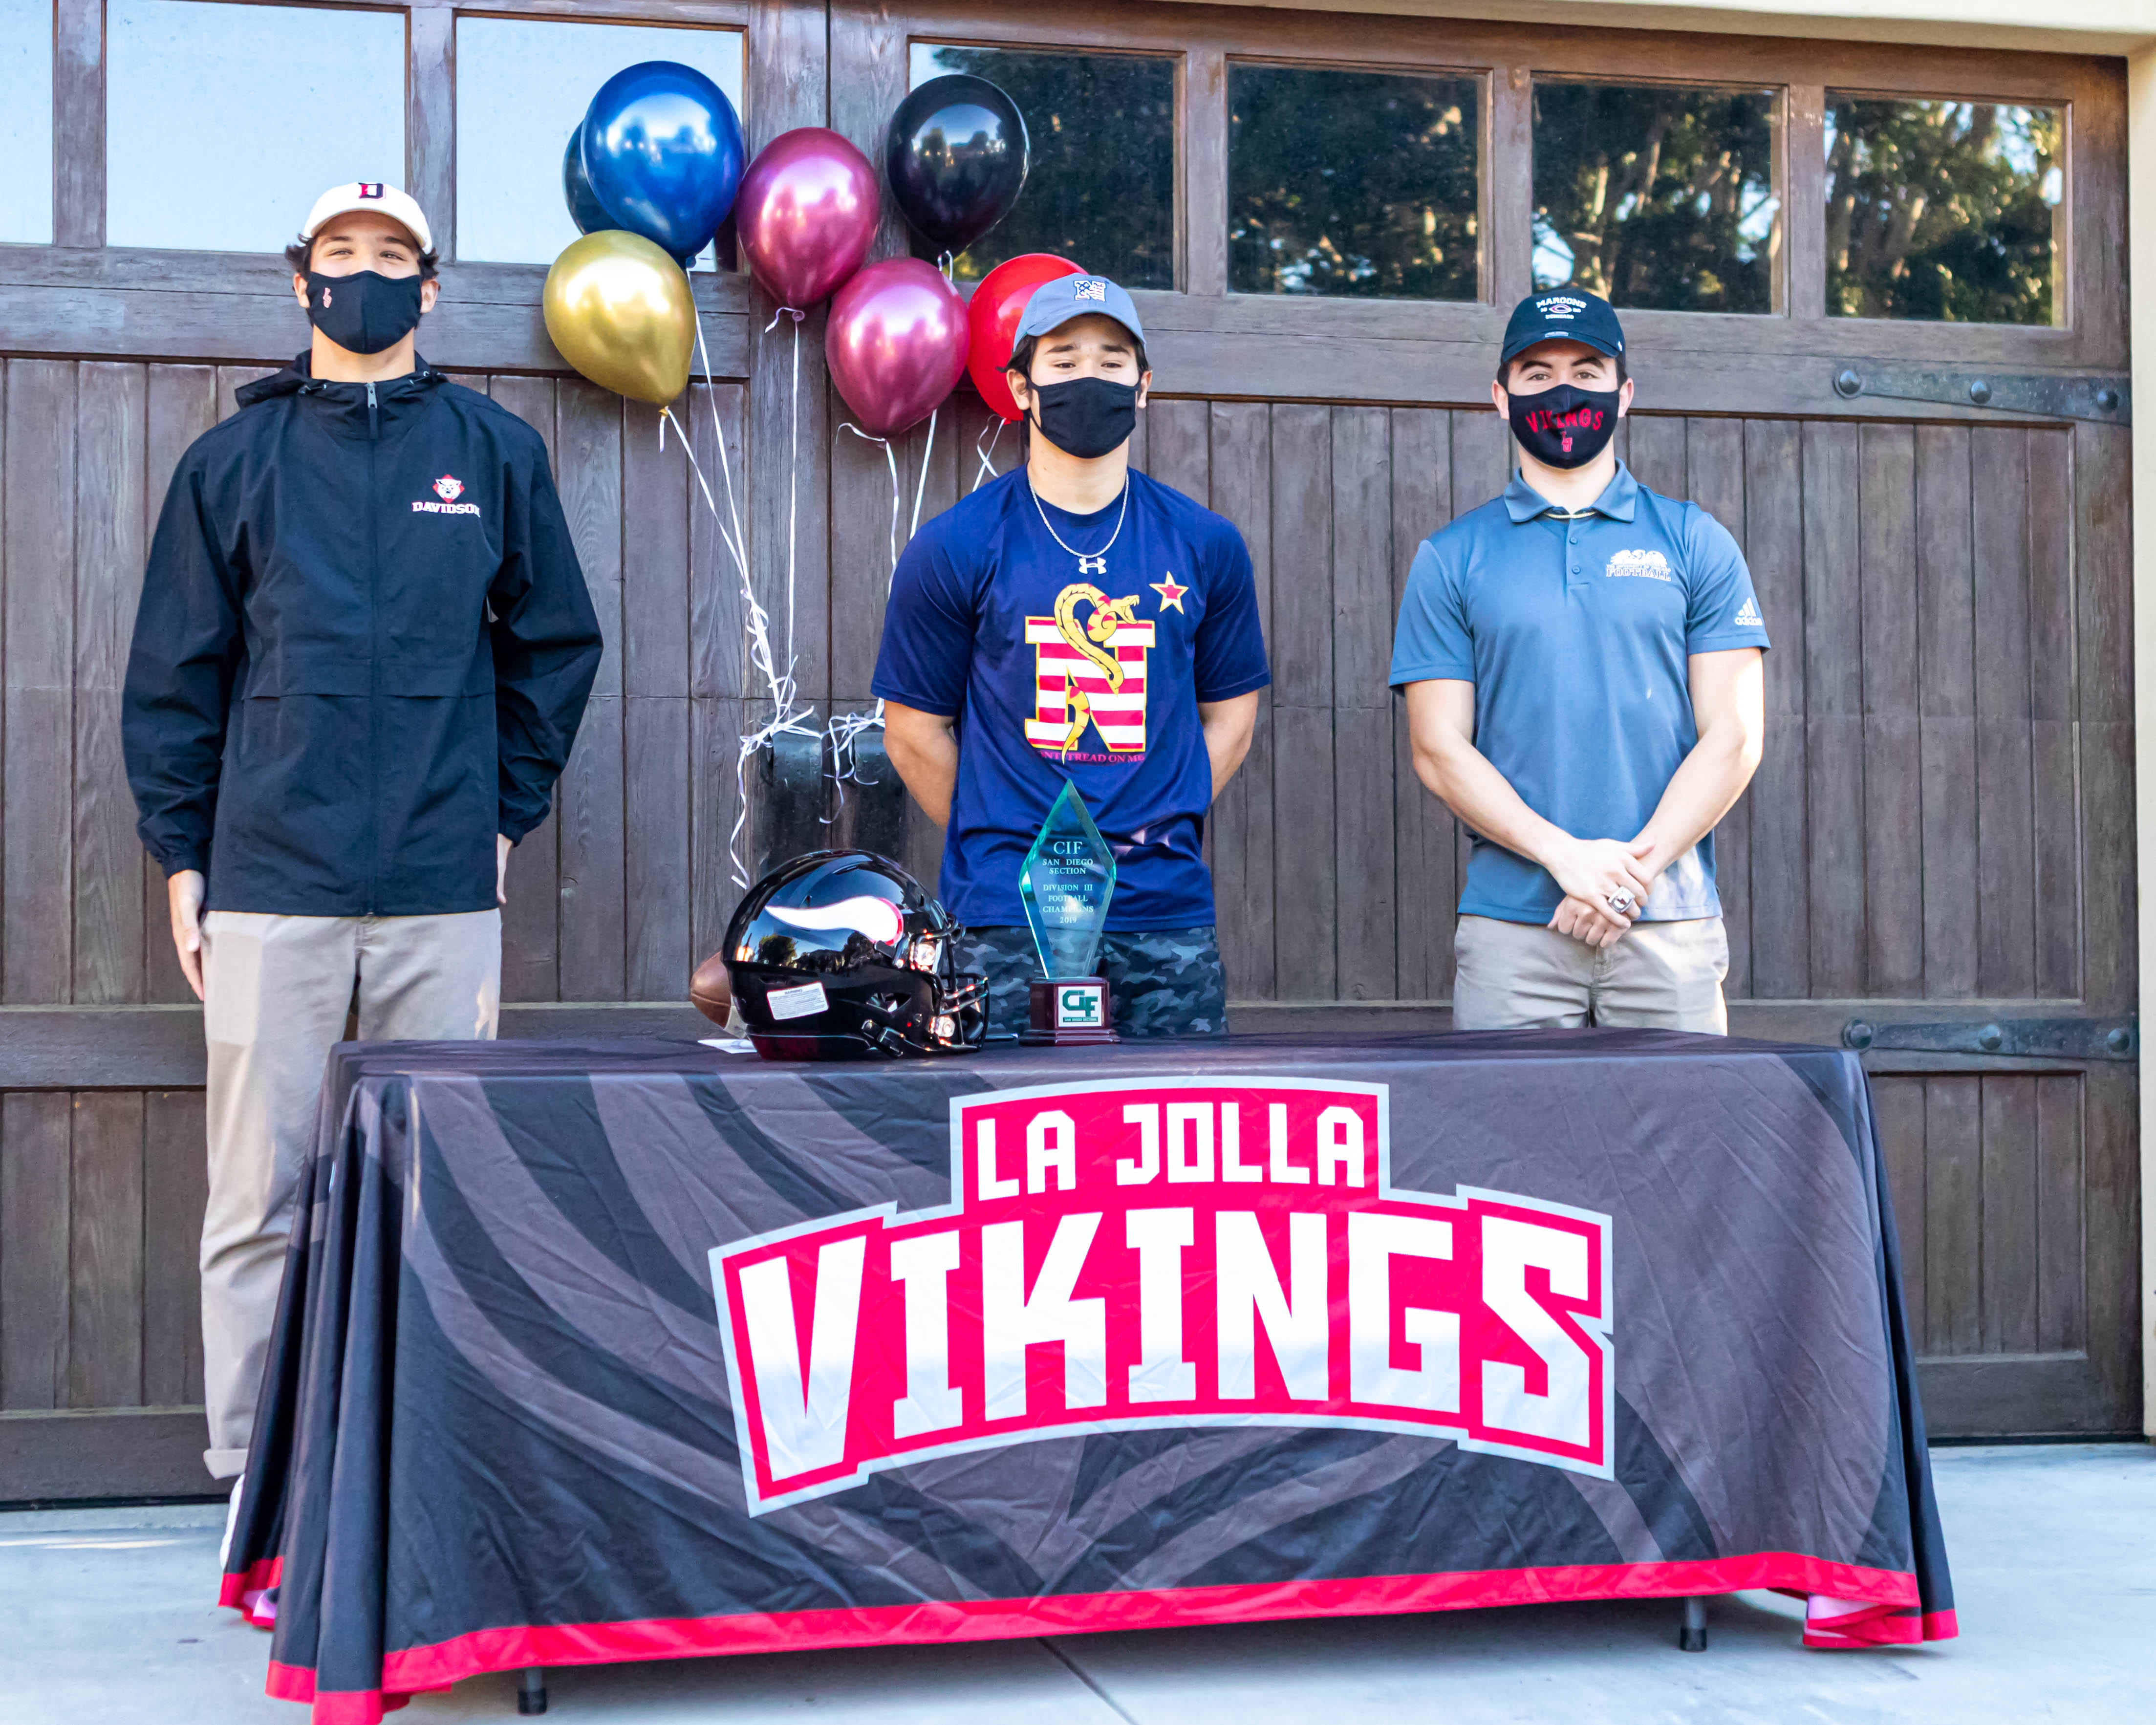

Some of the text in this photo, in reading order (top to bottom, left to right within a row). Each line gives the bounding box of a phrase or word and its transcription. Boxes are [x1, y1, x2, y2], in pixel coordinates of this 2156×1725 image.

[1536, 297, 1587, 308] MAROONS
[1606, 568, 1671, 582] FOOTBALL
[1068, 753, 1107, 763] TREAD
[1108, 755, 1124, 763] ON
[1054, 841, 1082, 854] CIF
[977, 1101, 1365, 1201] LA JOLLA
[738, 1207, 1591, 1482] VIKINGS
